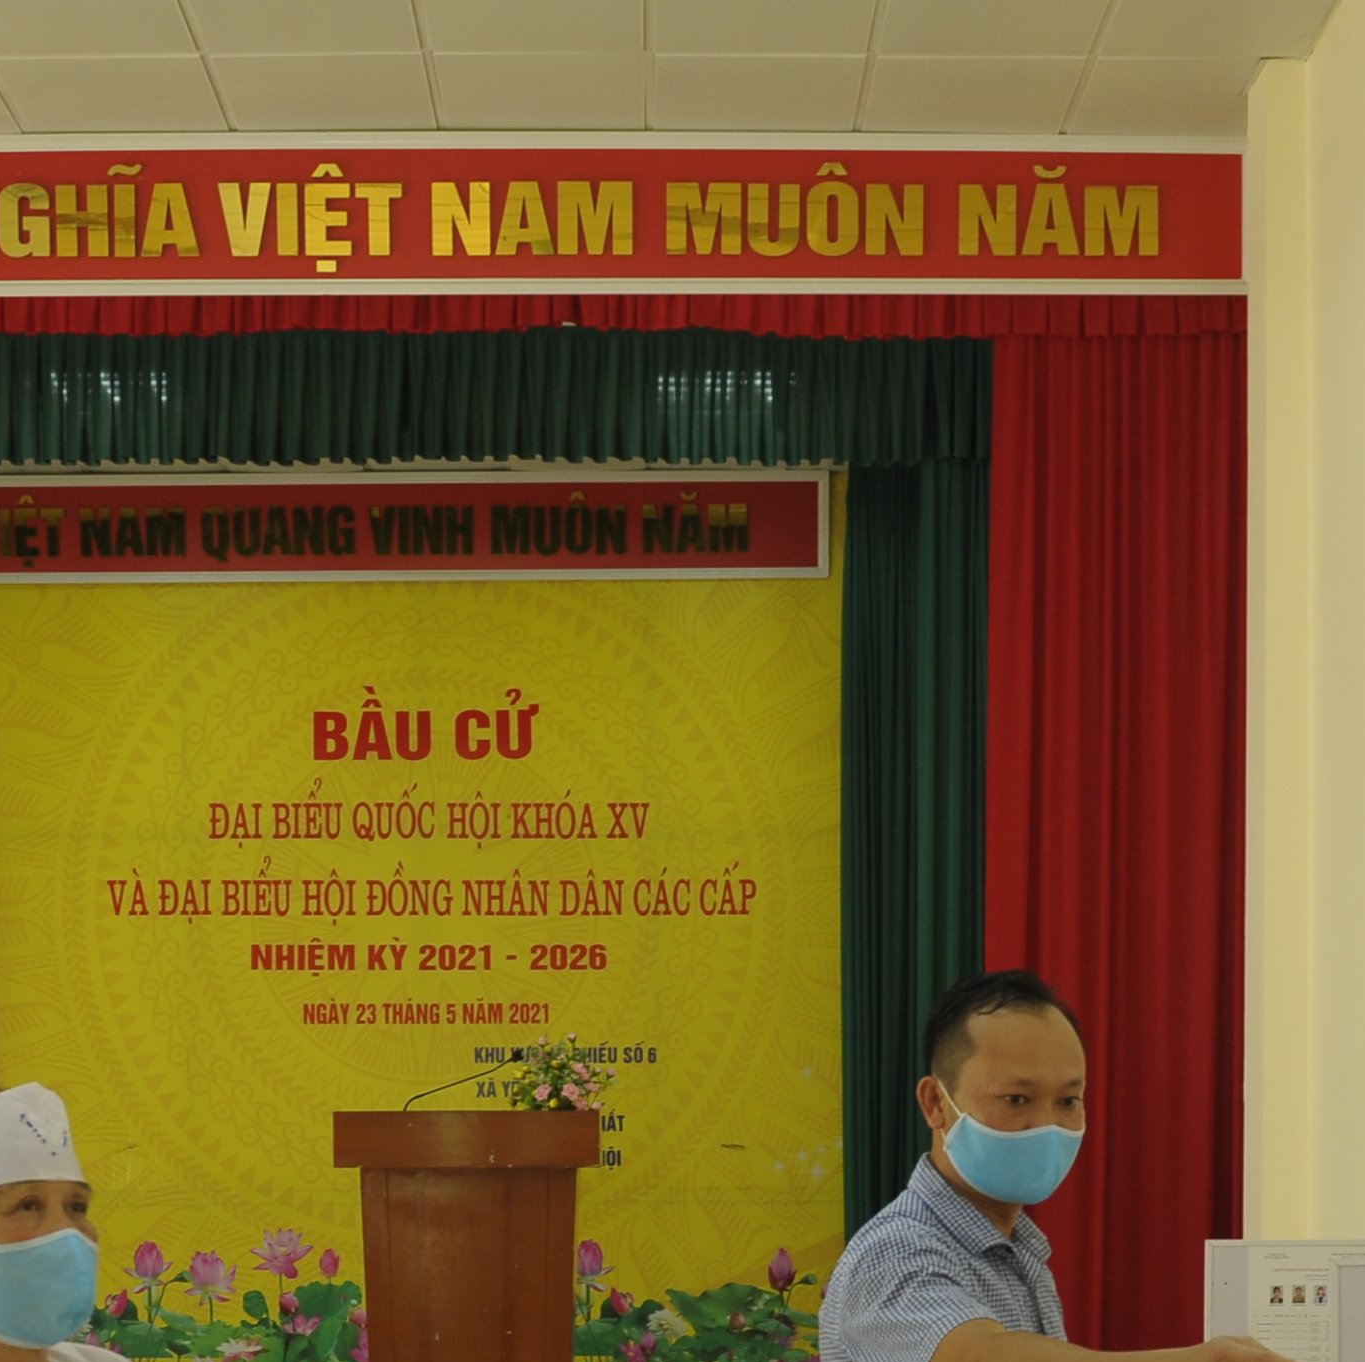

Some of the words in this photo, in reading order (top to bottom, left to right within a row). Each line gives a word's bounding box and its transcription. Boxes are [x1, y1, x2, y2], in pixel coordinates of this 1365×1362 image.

[217, 163, 402, 273] VIỆT
[432, 180, 634, 258] NAM
[666, 162, 925, 259] MUÔN
[957, 165, 1160, 257] NĂM
[79, 506, 187, 559] NAM
[201, 505, 356, 564] QUANG
[370, 504, 474, 557] VINH
[490, 490, 628, 555] MUÔN
[642, 491, 749, 554] NĂM
[310, 683, 434, 763] BẦU
[454, 687, 542, 763] CỬ
[208, 801, 264, 849] ĐẠI
[272, 777, 342, 841] BIỂU
[351, 783, 436, 843] QUỐC
[446, 790, 502, 849] HỘI
[509, 789, 598, 841] KHÓA
[606, 801, 651, 840] XV
[106, 868, 151, 918] VÀ
[158, 879, 213, 924] ĐẠI
[221, 856, 293, 918] BIỂU
[301, 869, 358, 926] HỘI
[366, 863, 454, 918] ĐỒNG
[461, 868, 551, 918] NHÂN
[559, 868, 625, 918] DÂN
[633, 867, 692, 918] CÁC
[698, 861, 758, 918] CẤP
[249, 937, 357, 977] NHIỆM
[366, 938, 407, 973] KỲ
[417, 943, 493, 973] 2021
[528, 942, 610, 973] 2026
[303, 998, 350, 1025] NGÀY
[355, 1003, 377, 1025] 23
[382, 998, 441, 1025] THÁNG
[446, 1003, 456, 1025] 5
[462, 998, 504, 1025] NĂM
[509, 1002, 550, 1025] 2021
[475, 1046, 505, 1064] KHU
[623, 1041, 645, 1064] SỐ
[648, 1047, 657, 1064] 6
[476, 1078, 498, 1098] XÃ
